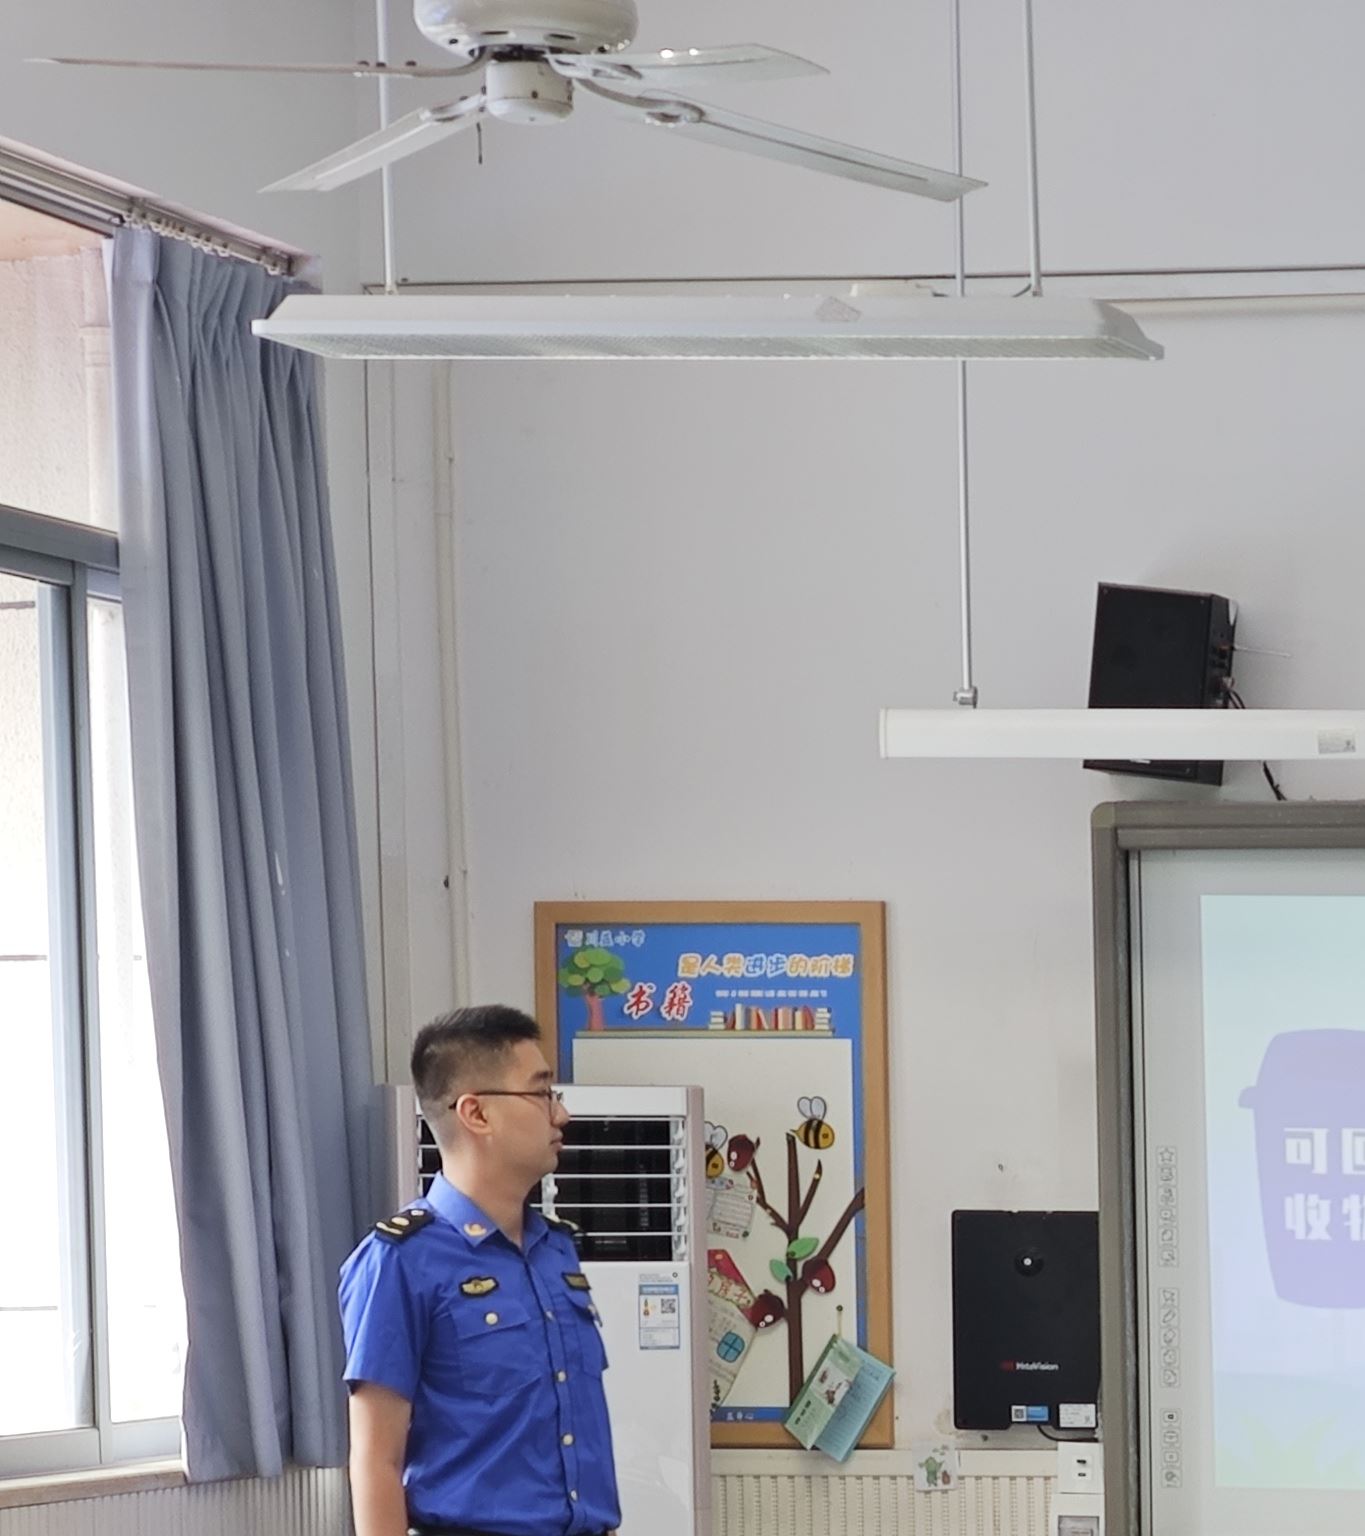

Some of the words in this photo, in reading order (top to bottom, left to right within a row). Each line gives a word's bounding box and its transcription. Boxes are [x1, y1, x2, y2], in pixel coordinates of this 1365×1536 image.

[678, 953, 854, 978] 是人类进步的阶梯
[623, 981, 693, 1020] 书籍
